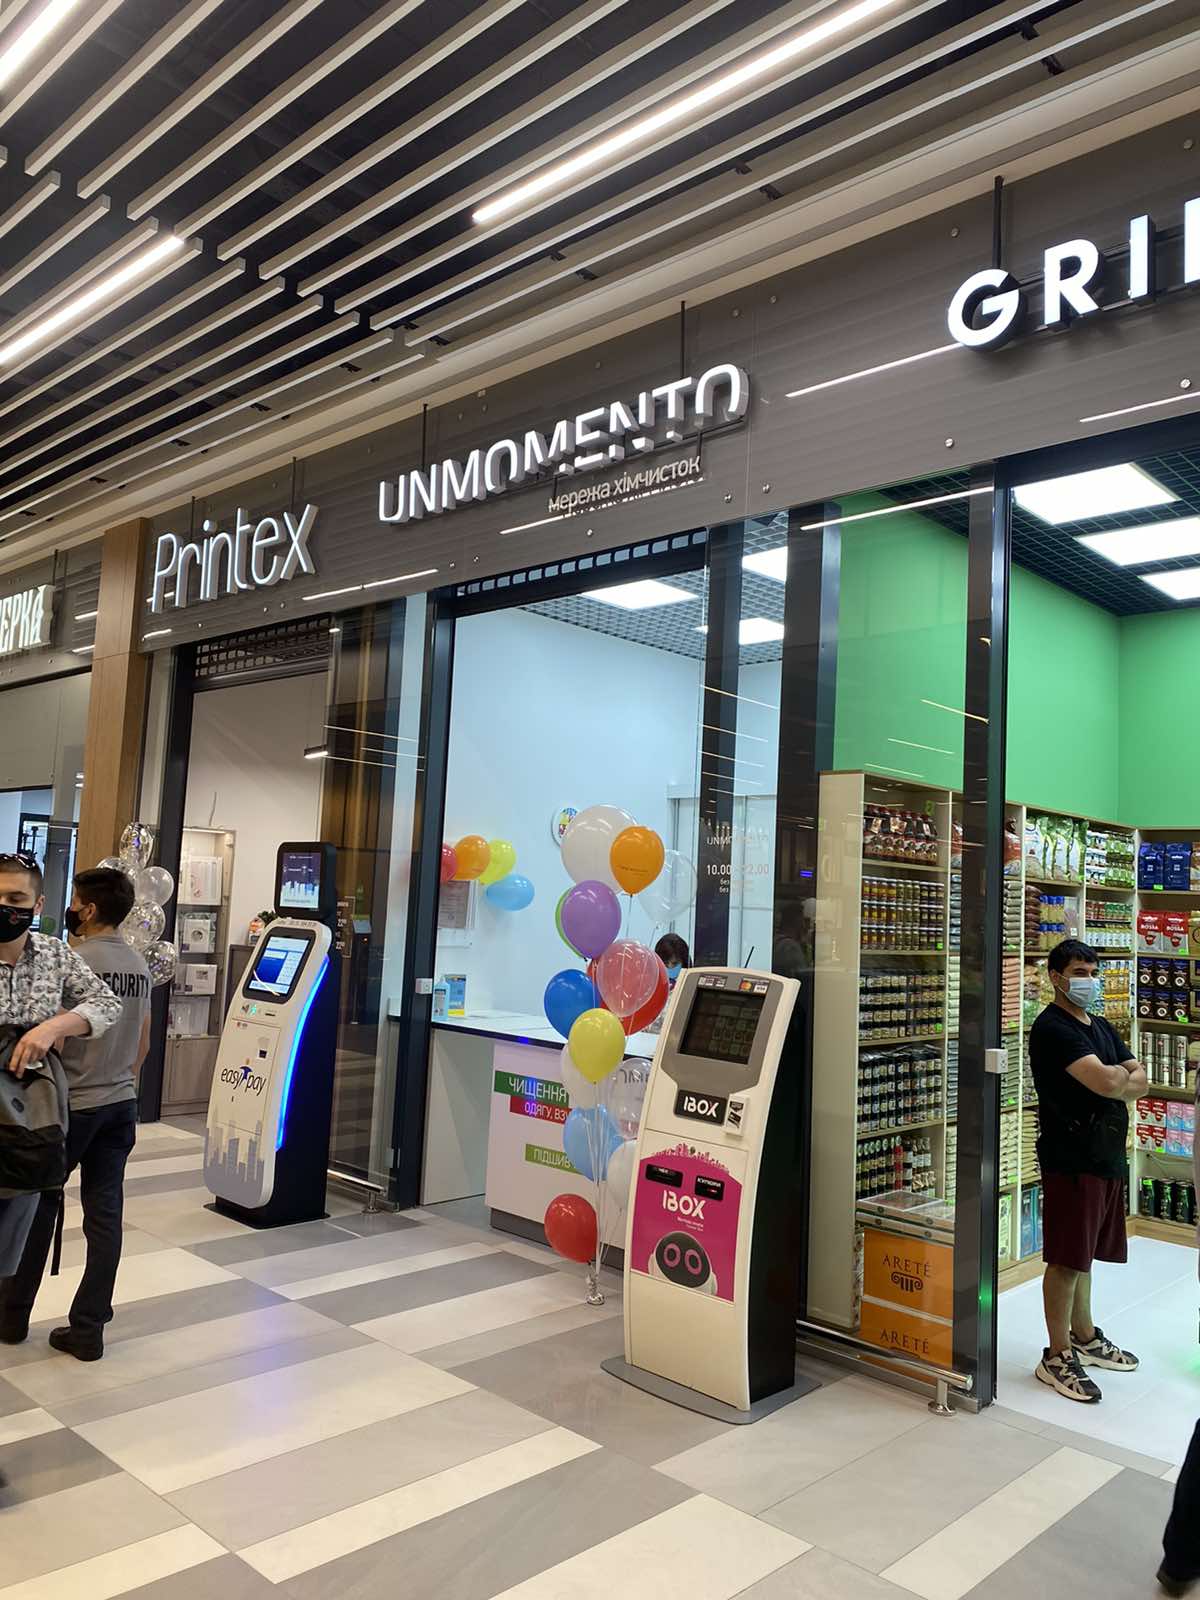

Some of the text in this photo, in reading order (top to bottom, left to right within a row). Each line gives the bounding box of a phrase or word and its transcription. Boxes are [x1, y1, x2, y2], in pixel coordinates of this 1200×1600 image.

[378, 363, 750, 524] UNMOMENTO
[549, 456, 701, 514] мережа хімчисток
[151, 504, 319, 614] Printex
[95, 972, 149, 999] ECURITY
[509, 1076, 567, 1103] ЧИЩЕННЯ
[524, 1101, 553, 1119] ОДЯГУ,
[683, 1096, 719, 1118] IBOX
[533, 1148, 576, 1169] ПІДШИВ
[662, 1189, 706, 1220] IBOX
